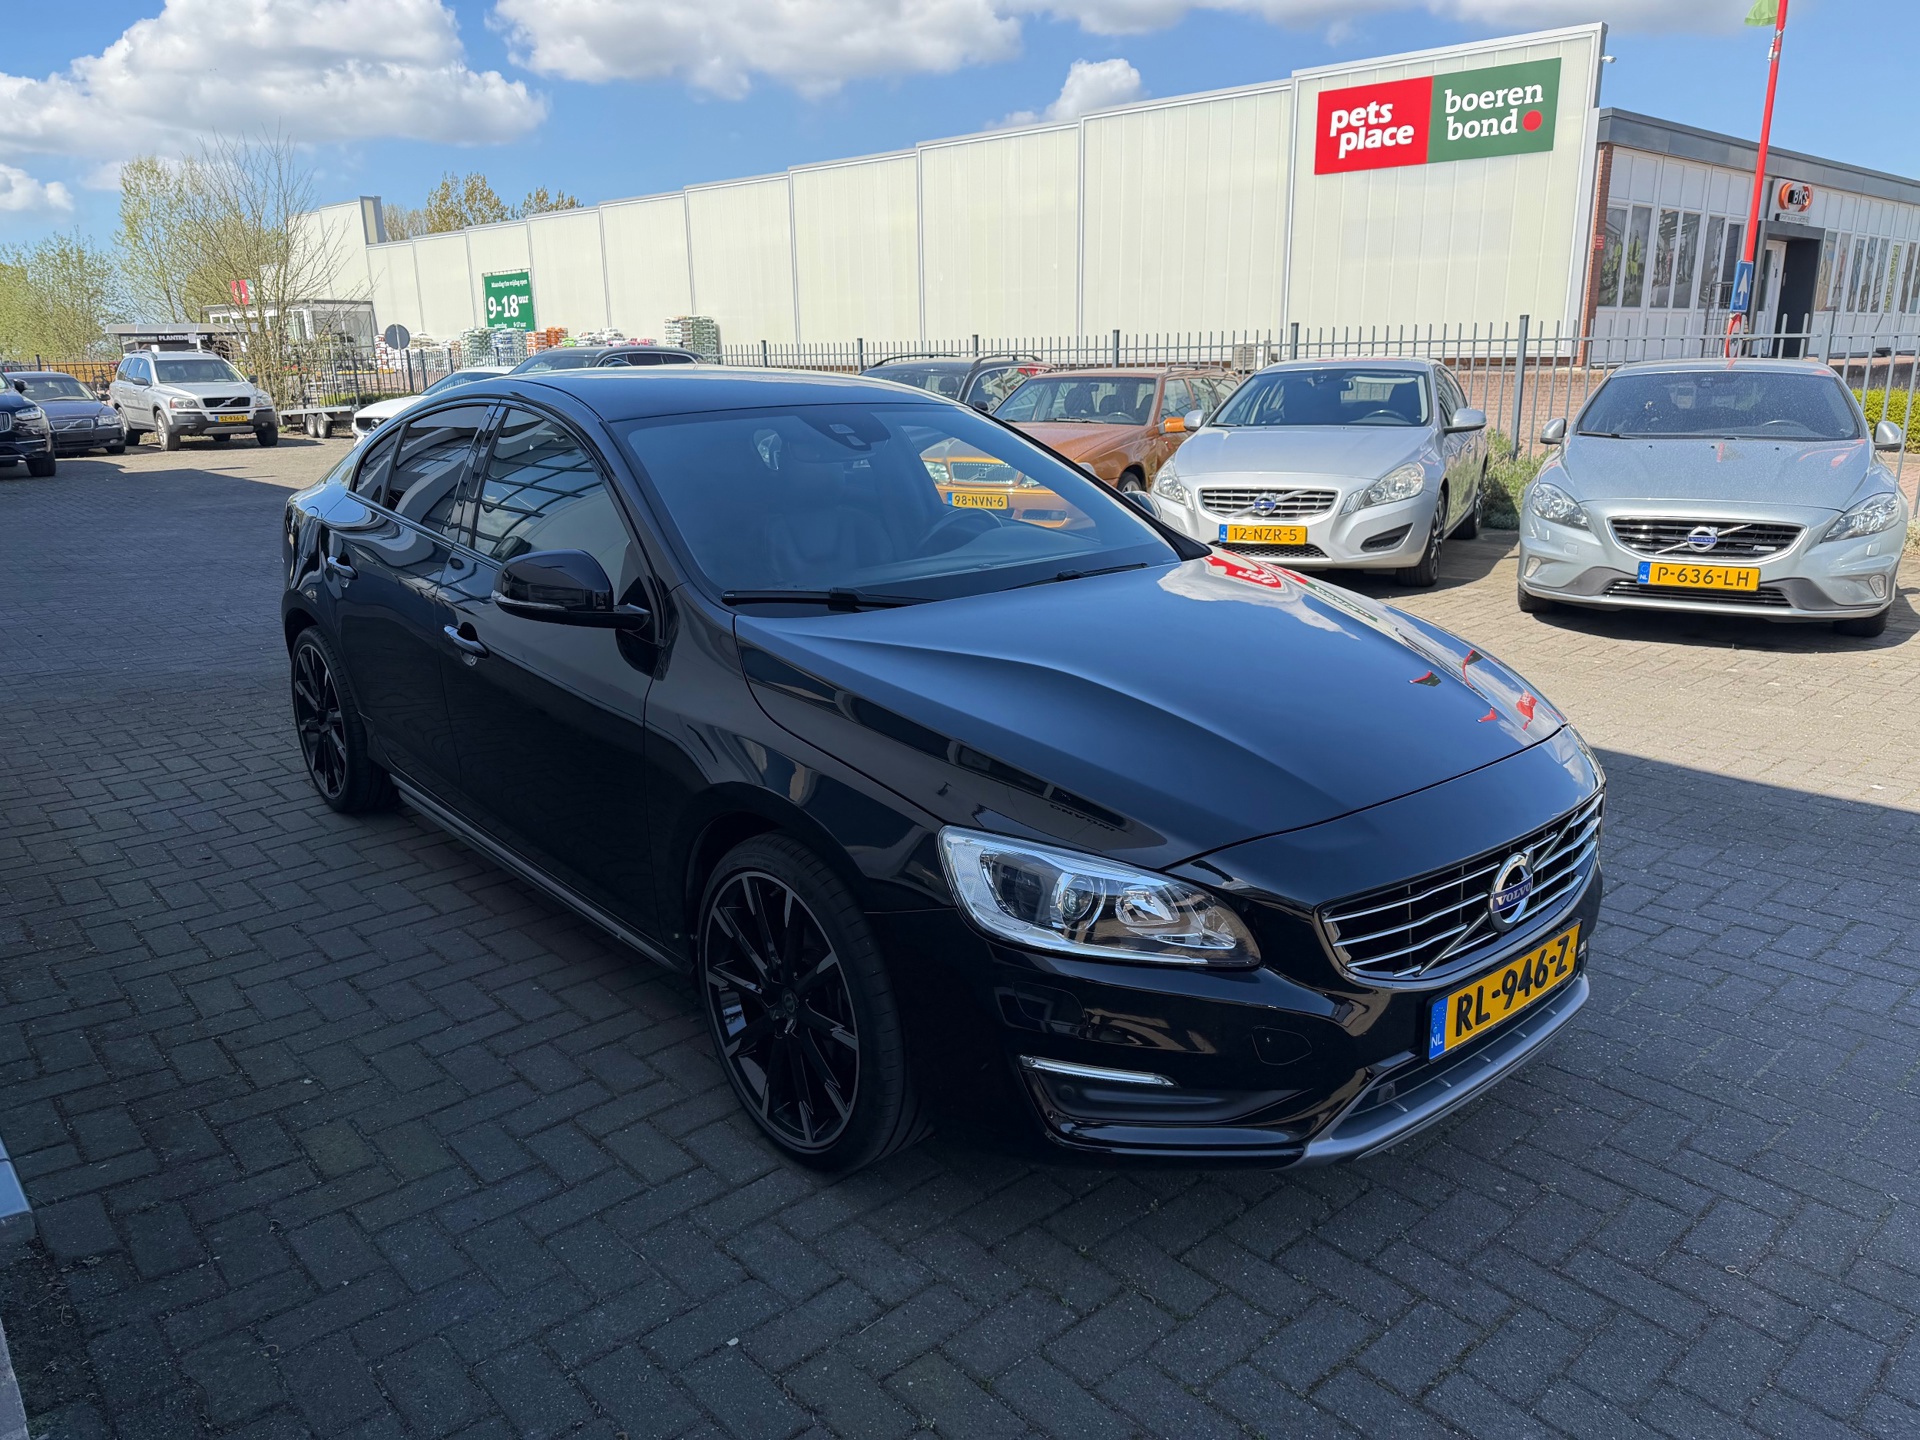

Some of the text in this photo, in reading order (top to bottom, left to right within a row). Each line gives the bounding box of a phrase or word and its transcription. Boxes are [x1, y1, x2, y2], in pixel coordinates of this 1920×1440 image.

[1444, 83, 1543, 114] boeren
[1329, 101, 1393, 137] pets
[1446, 108, 1518, 140] bond
[1338, 124, 1414, 159] place
[1793, 190, 1809, 205] BKS
[488, 294, 519, 319] 9-18
[954, 495, 1004, 507] 98-NVN-6
[1233, 528, 1298, 541] 12-NZR-5
[1657, 566, 1750, 587] P-636-LH
[1495, 882, 1531, 906] VOLVO
[1431, 935, 1570, 1049] NL RL-946-Z
